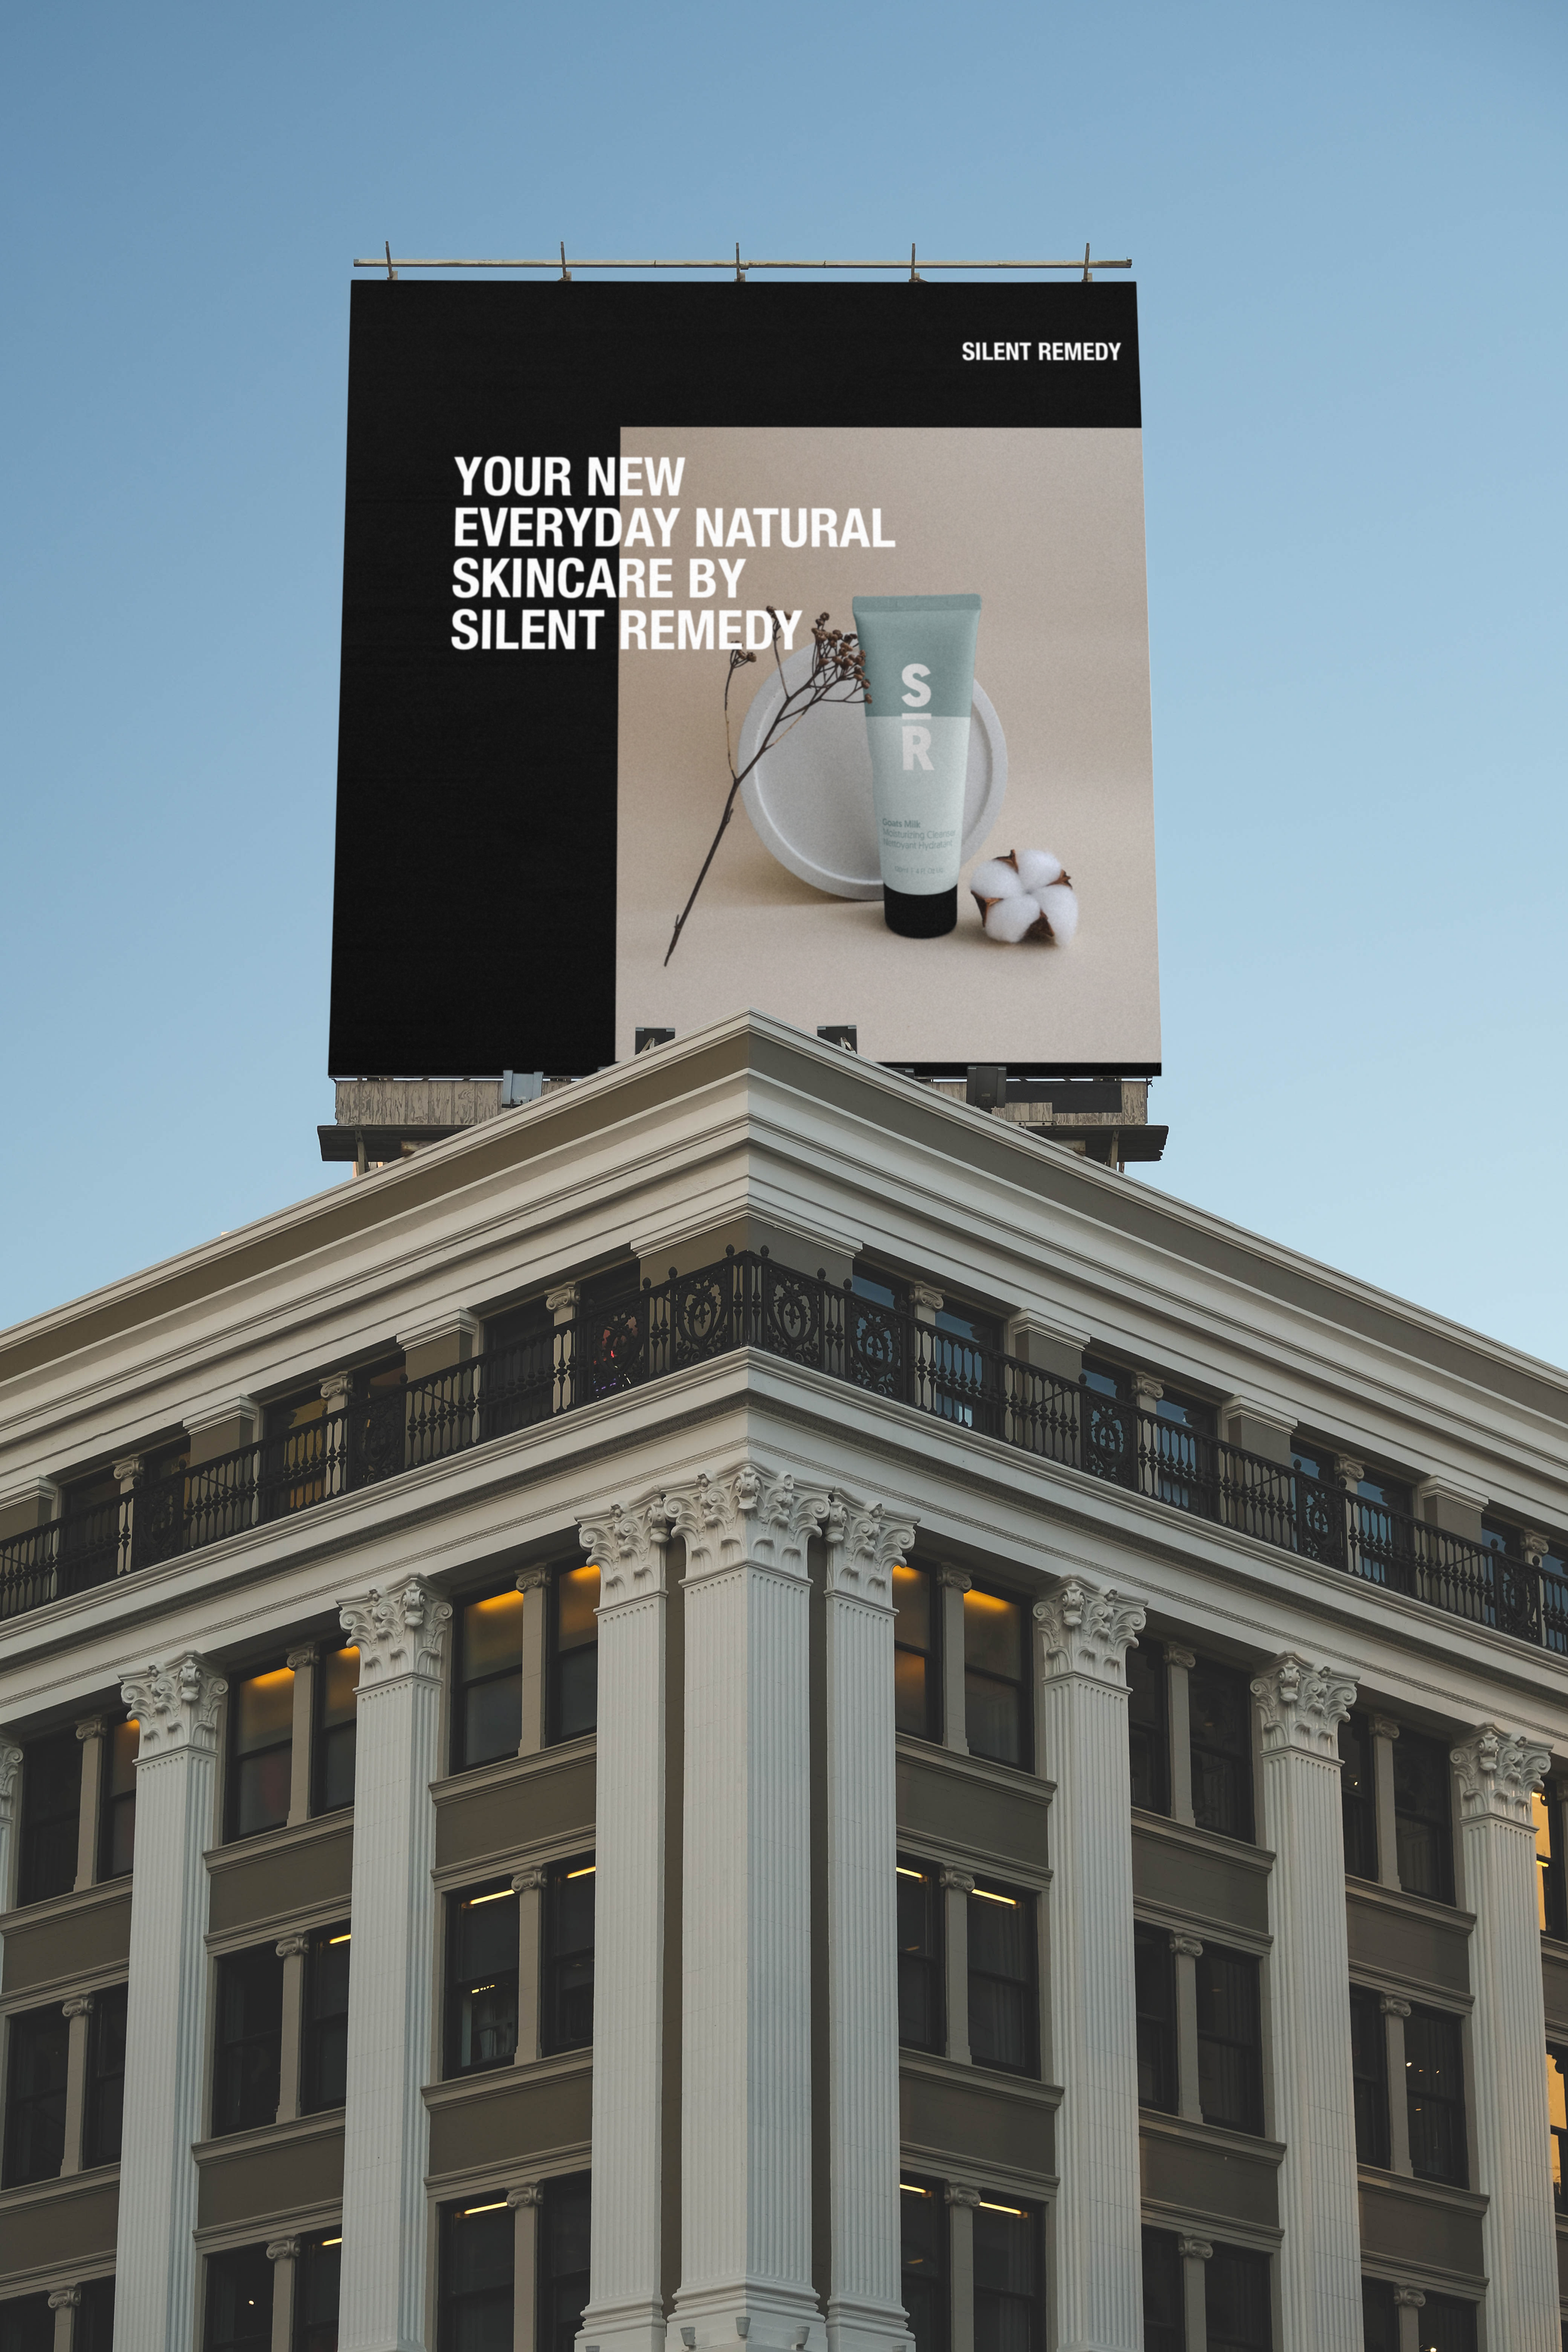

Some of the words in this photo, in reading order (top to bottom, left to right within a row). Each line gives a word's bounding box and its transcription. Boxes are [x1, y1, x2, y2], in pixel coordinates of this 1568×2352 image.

[963, 342, 1031, 361] SILENT
[1039, 342, 1121, 361] REMEDY
[455, 456, 571, 496] YOUR
[588, 457, 686, 496] NEW
[455, 507, 681, 547] EVERYDAY
[696, 507, 896, 548] NATURAL
[452, 558, 673, 598] SKINCARE
[689, 558, 746, 598] BY
[452, 609, 605, 650] SILENT
[620, 610, 803, 650] REMEDY
[901, 663, 931, 707] S
[902, 726, 935, 771] R
[882, 818, 903, 828] Goats
[904, 820, 921, 829] Milk
[882, 828, 924, 840] Moisturizing
[926, 830, 956, 839] Cleanser
[883, 838, 916, 850] Nettoyant
[918, 840, 953, 850] Hydratant
